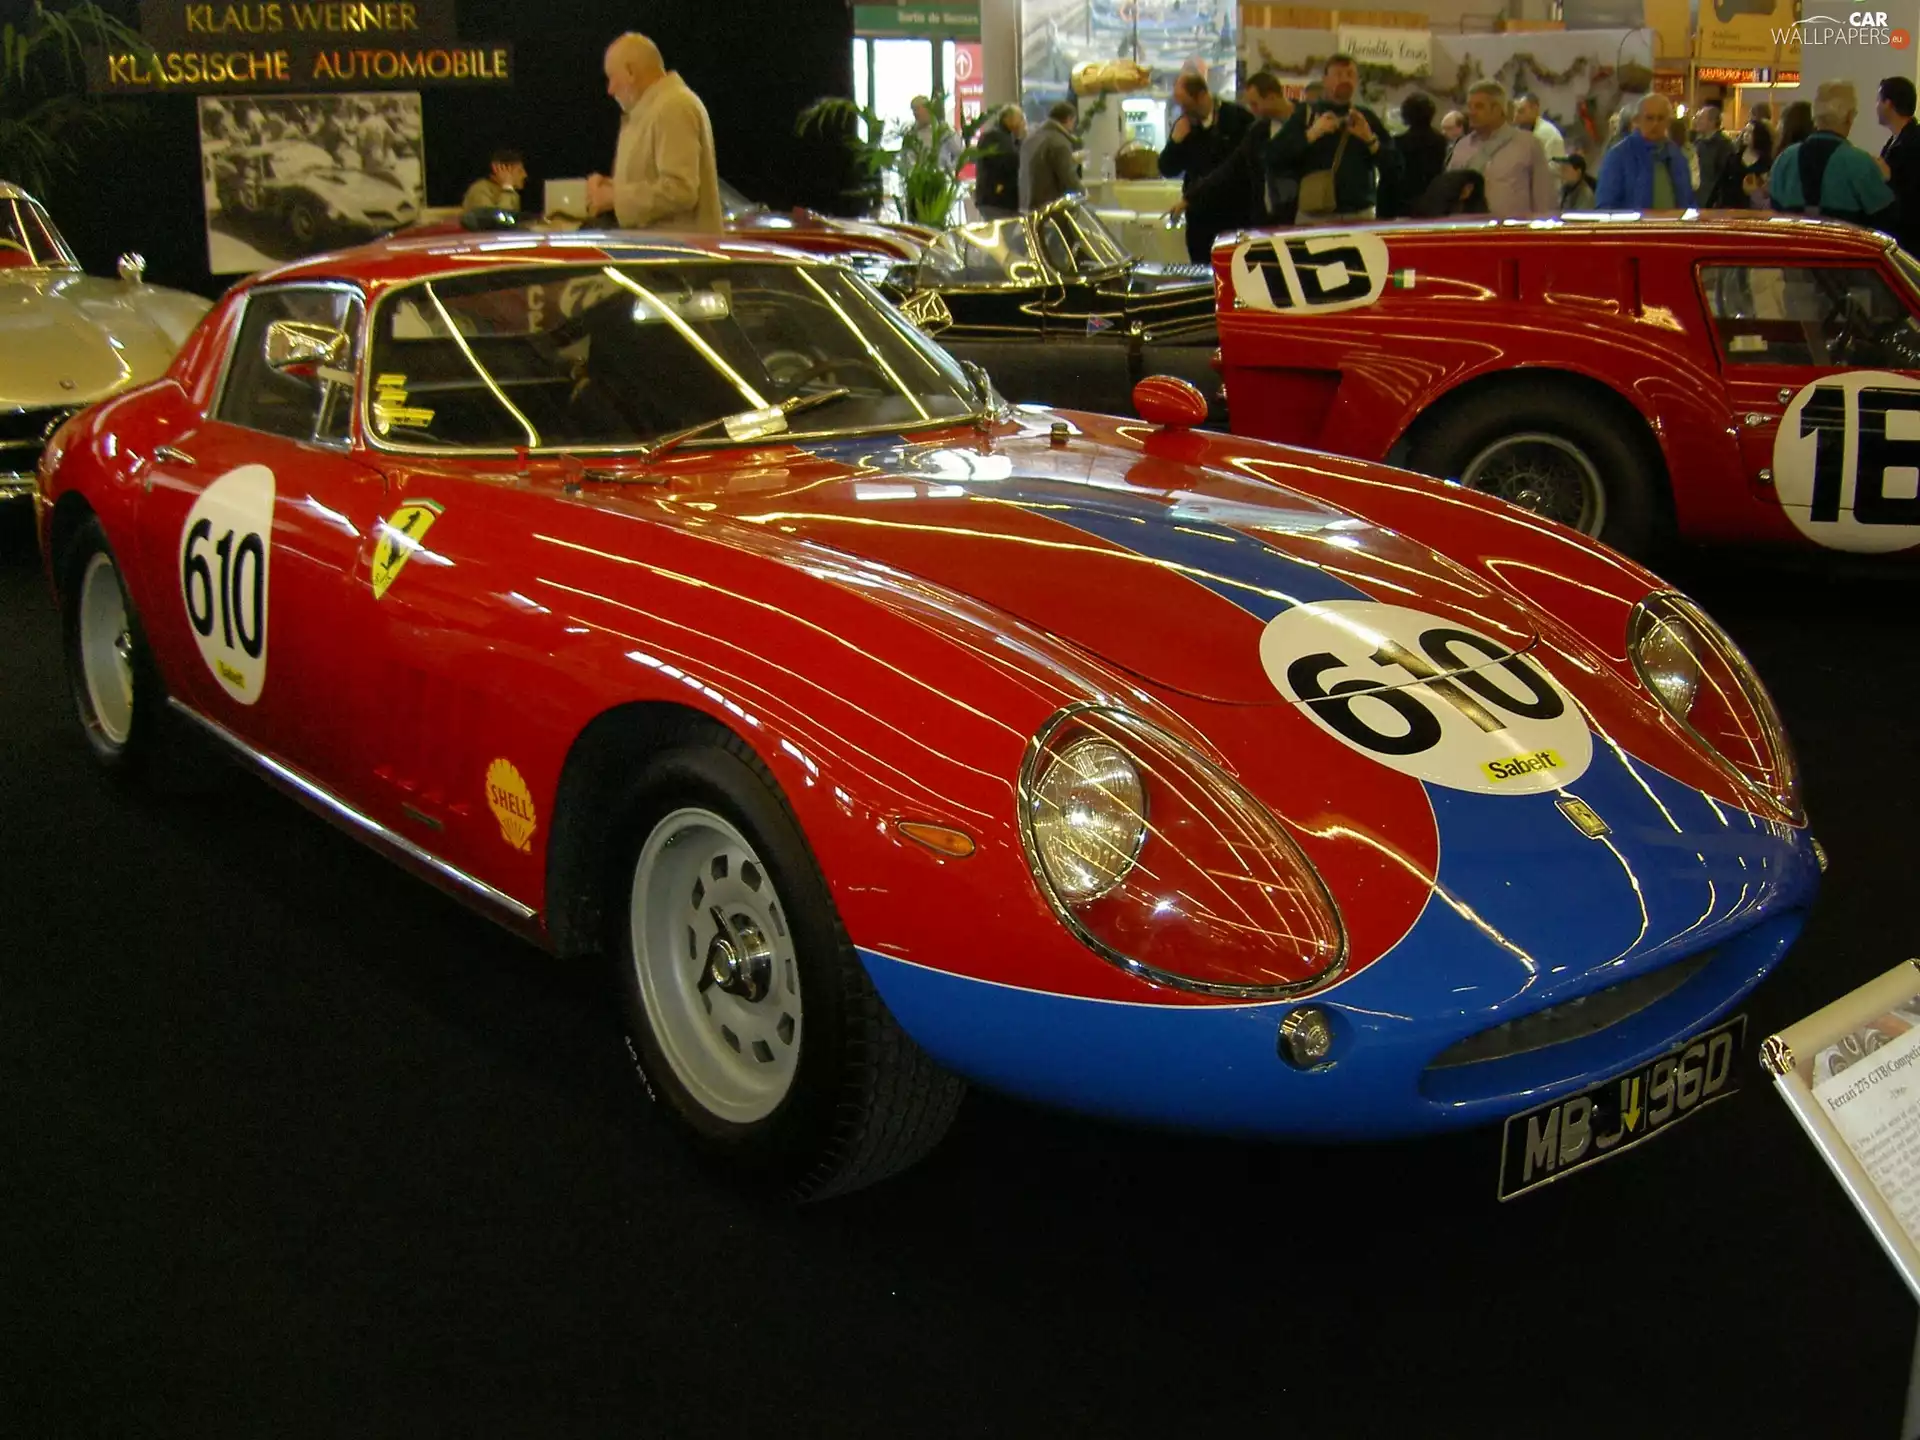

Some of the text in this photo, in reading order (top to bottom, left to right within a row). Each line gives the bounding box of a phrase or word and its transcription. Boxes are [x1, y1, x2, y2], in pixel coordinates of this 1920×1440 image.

[185, 2, 419, 33] KLAUS WERNER
[108, 49, 509, 84] KLASSISCHE AUTOMOBILE
[1244, 235, 1373, 309] 16
[183, 517, 265, 659] 610
[1287, 628, 1565, 756] 610
[1488, 750, 1557, 779] Sabelt
[491, 784, 531, 822] SHELL
[1827, 1084, 1858, 1110] Ferrari
[1854, 1077, 1870, 1095] 275
